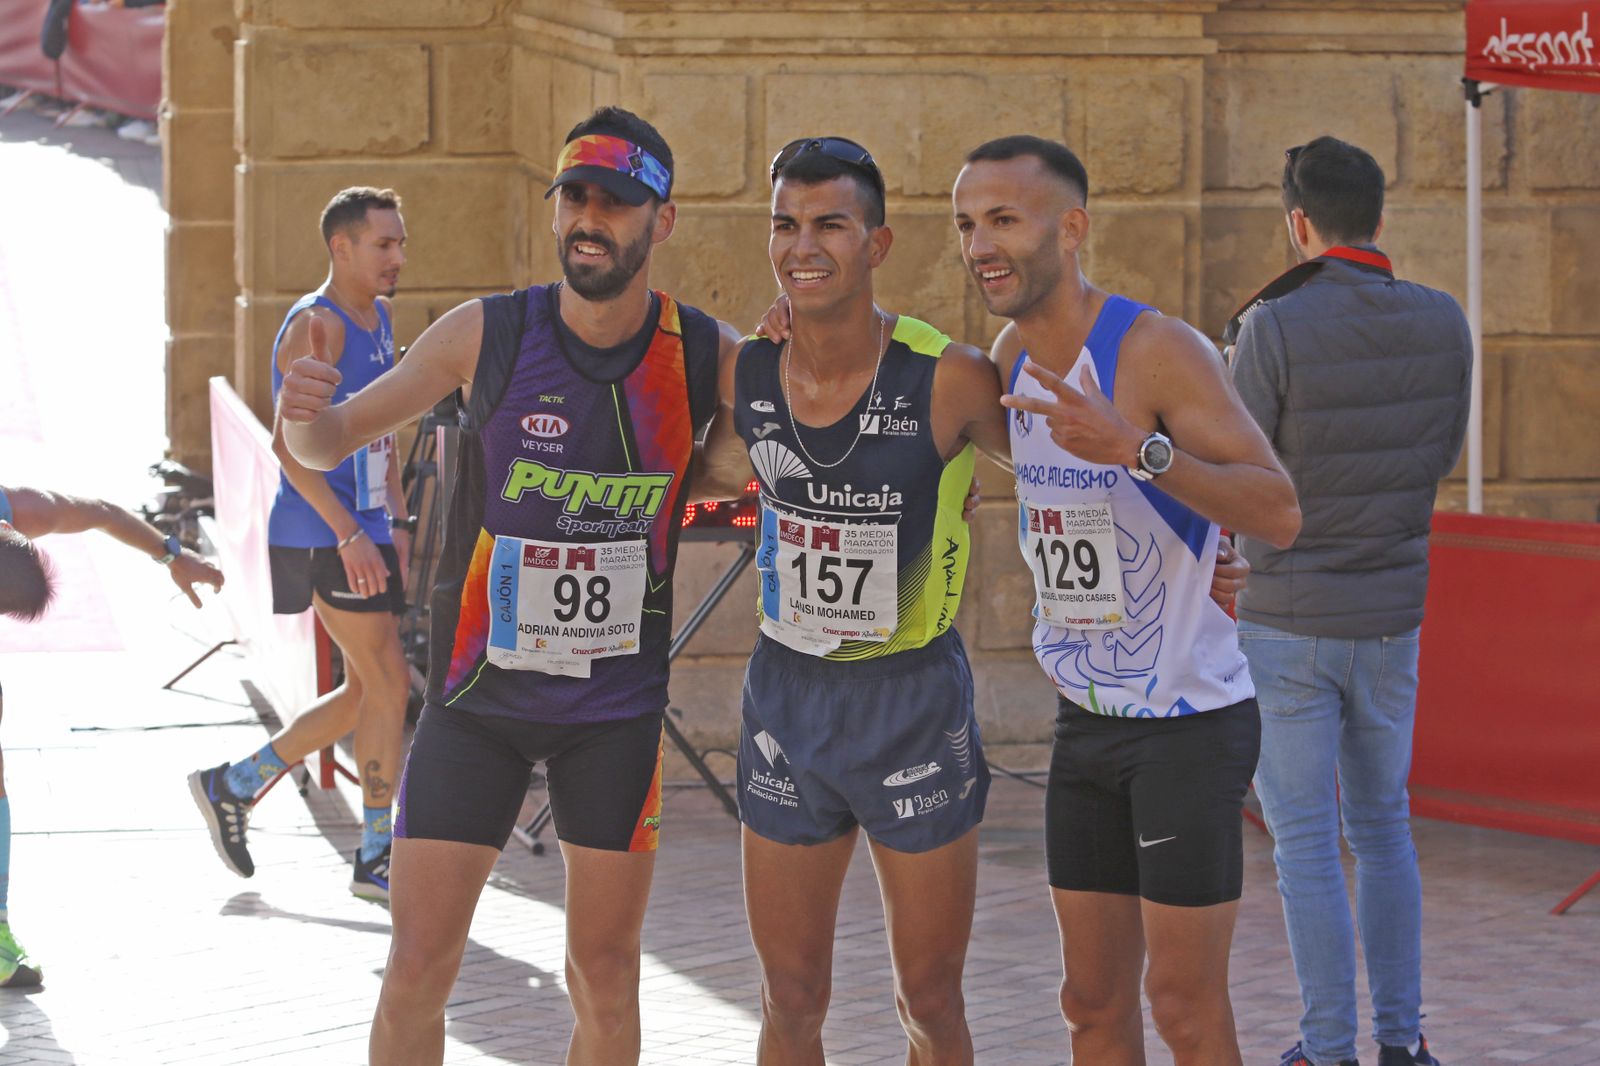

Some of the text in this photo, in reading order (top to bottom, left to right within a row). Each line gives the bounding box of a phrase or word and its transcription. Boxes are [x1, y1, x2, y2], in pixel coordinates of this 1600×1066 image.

[538, 394, 565, 404] TACTIC
[527, 417, 562, 434] KIA
[882, 414, 918, 431] Jaén
[521, 438, 564, 454] VEYSER
[1047, 465, 1118, 490] ATLETISMO
[807, 482, 903, 512] Unicaja
[1065, 508, 1109, 518] 35 MEDIA
[1066, 516, 1111, 527] MARATÓN
[780, 529, 805, 546] IMDECO
[844, 529, 894, 538] 35 MEDIA
[844, 537, 894, 547] MARATÓN
[600, 553, 645, 564] MARATÓN
[601, 545, 645, 556] 35 MEDIA
[524, 556, 559, 567] IMDECO
[763, 534, 776, 593] CAÓN 1
[1035, 537, 1100, 590] 129
[791, 551, 874, 605] 157
[497, 563, 513, 623] CAJÓN 1
[553, 573, 611, 623] 98
[1058, 593, 1084, 602] MORENO
[1085, 593, 1117, 602] CASARES
[789, 597, 876, 621] LANSI MOHAMED
[1064, 616, 1095, 625] Cruzcampo
[518, 622, 635, 638] ADRIAN ANDIVIA SOTO
[822, 626, 860, 637] Cruzcampo
[571, 645, 607, 655] Cruzcampo
[752, 768, 795, 793] Unicaja
[747, 784, 798, 808] Fundación Jaén
[914, 788, 948, 811] Jaén
